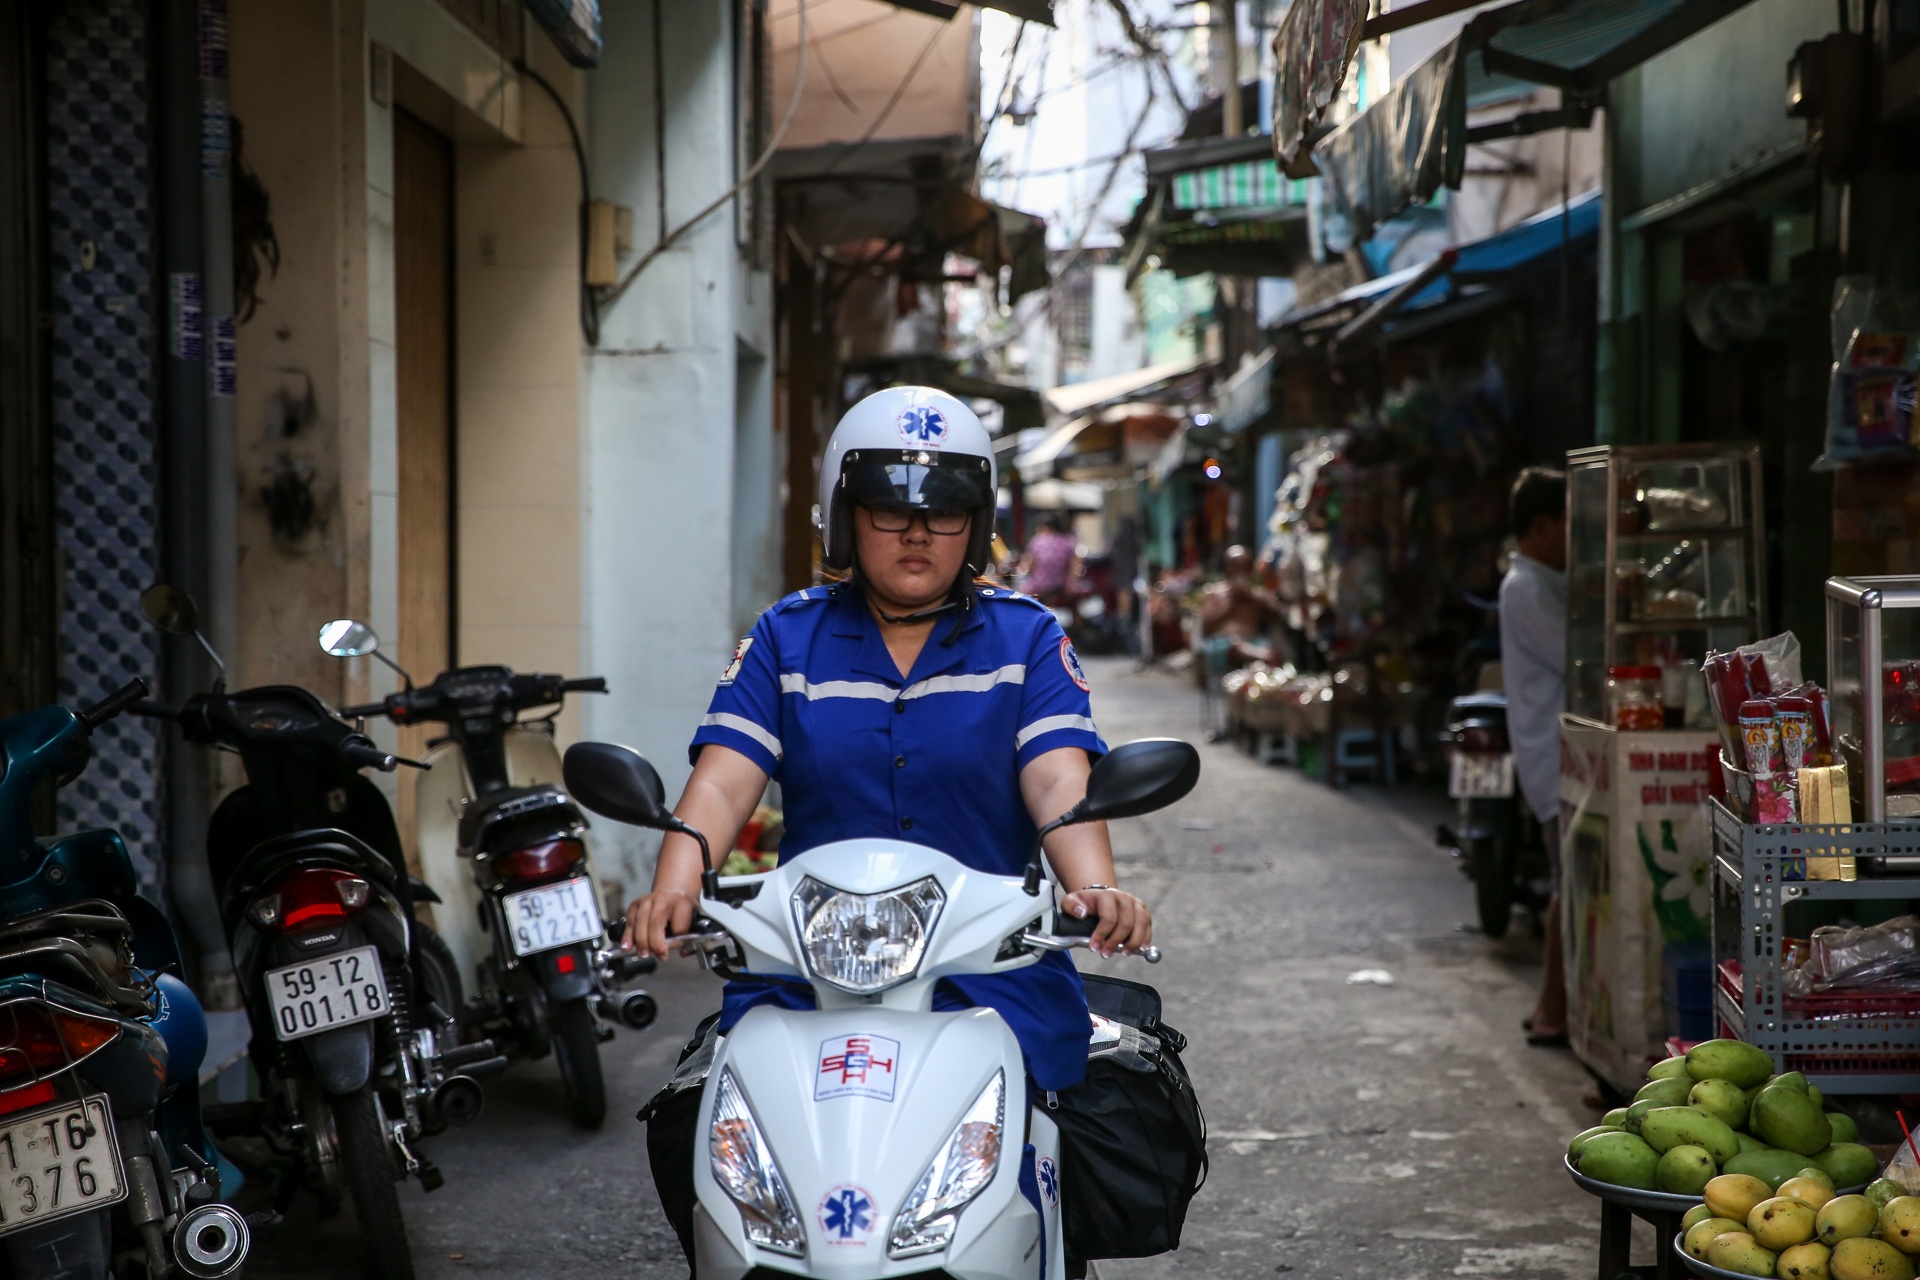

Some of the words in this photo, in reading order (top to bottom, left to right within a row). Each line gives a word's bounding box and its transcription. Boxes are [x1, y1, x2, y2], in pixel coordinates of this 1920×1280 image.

[517, 886, 579, 921] 59-T1
[517, 910, 594, 949] 912.21
[281, 956, 364, 999] 59-T2
[280, 983, 381, 1034] 001.18
